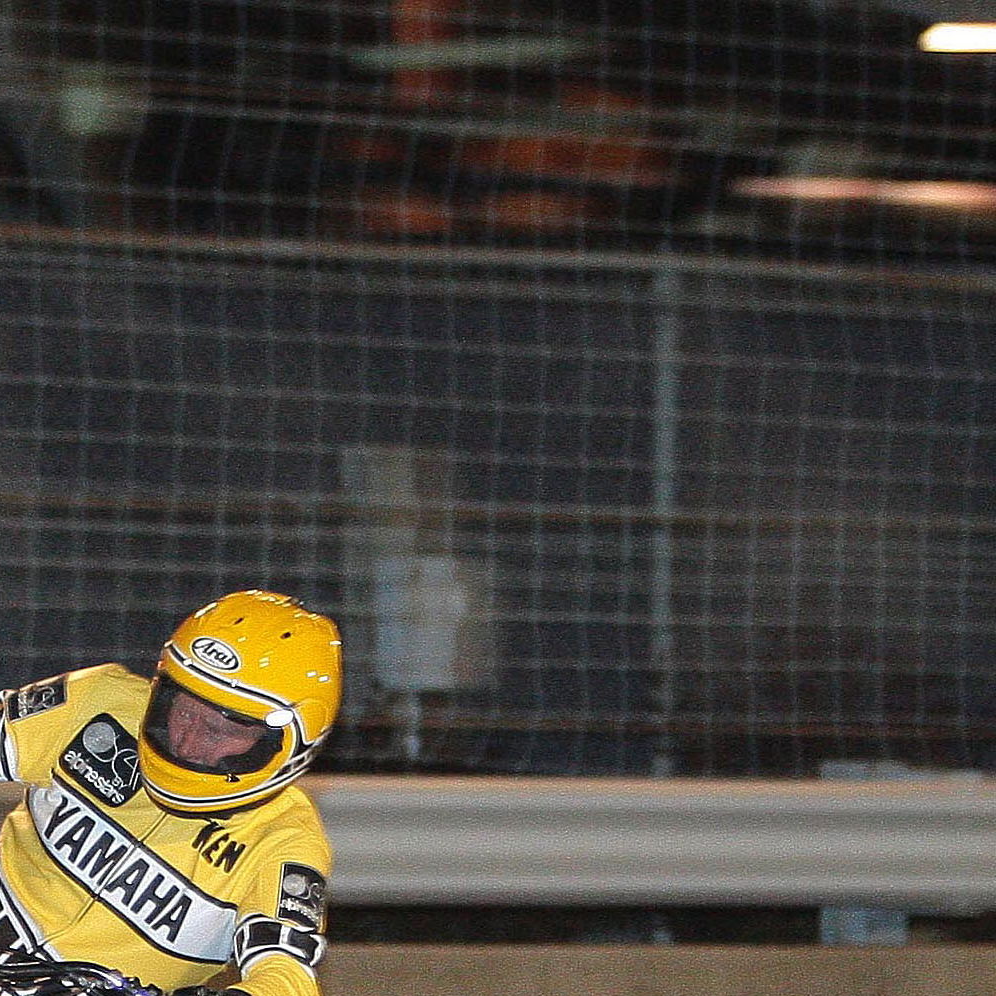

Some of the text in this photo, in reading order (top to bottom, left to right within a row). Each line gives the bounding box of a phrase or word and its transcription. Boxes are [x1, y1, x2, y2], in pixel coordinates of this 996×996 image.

[194, 641, 235, 665] Arai
[64, 750, 124, 803] alpinestars
[43, 796, 192, 944] YAMAHA
[192, 821, 246, 873] KEN
